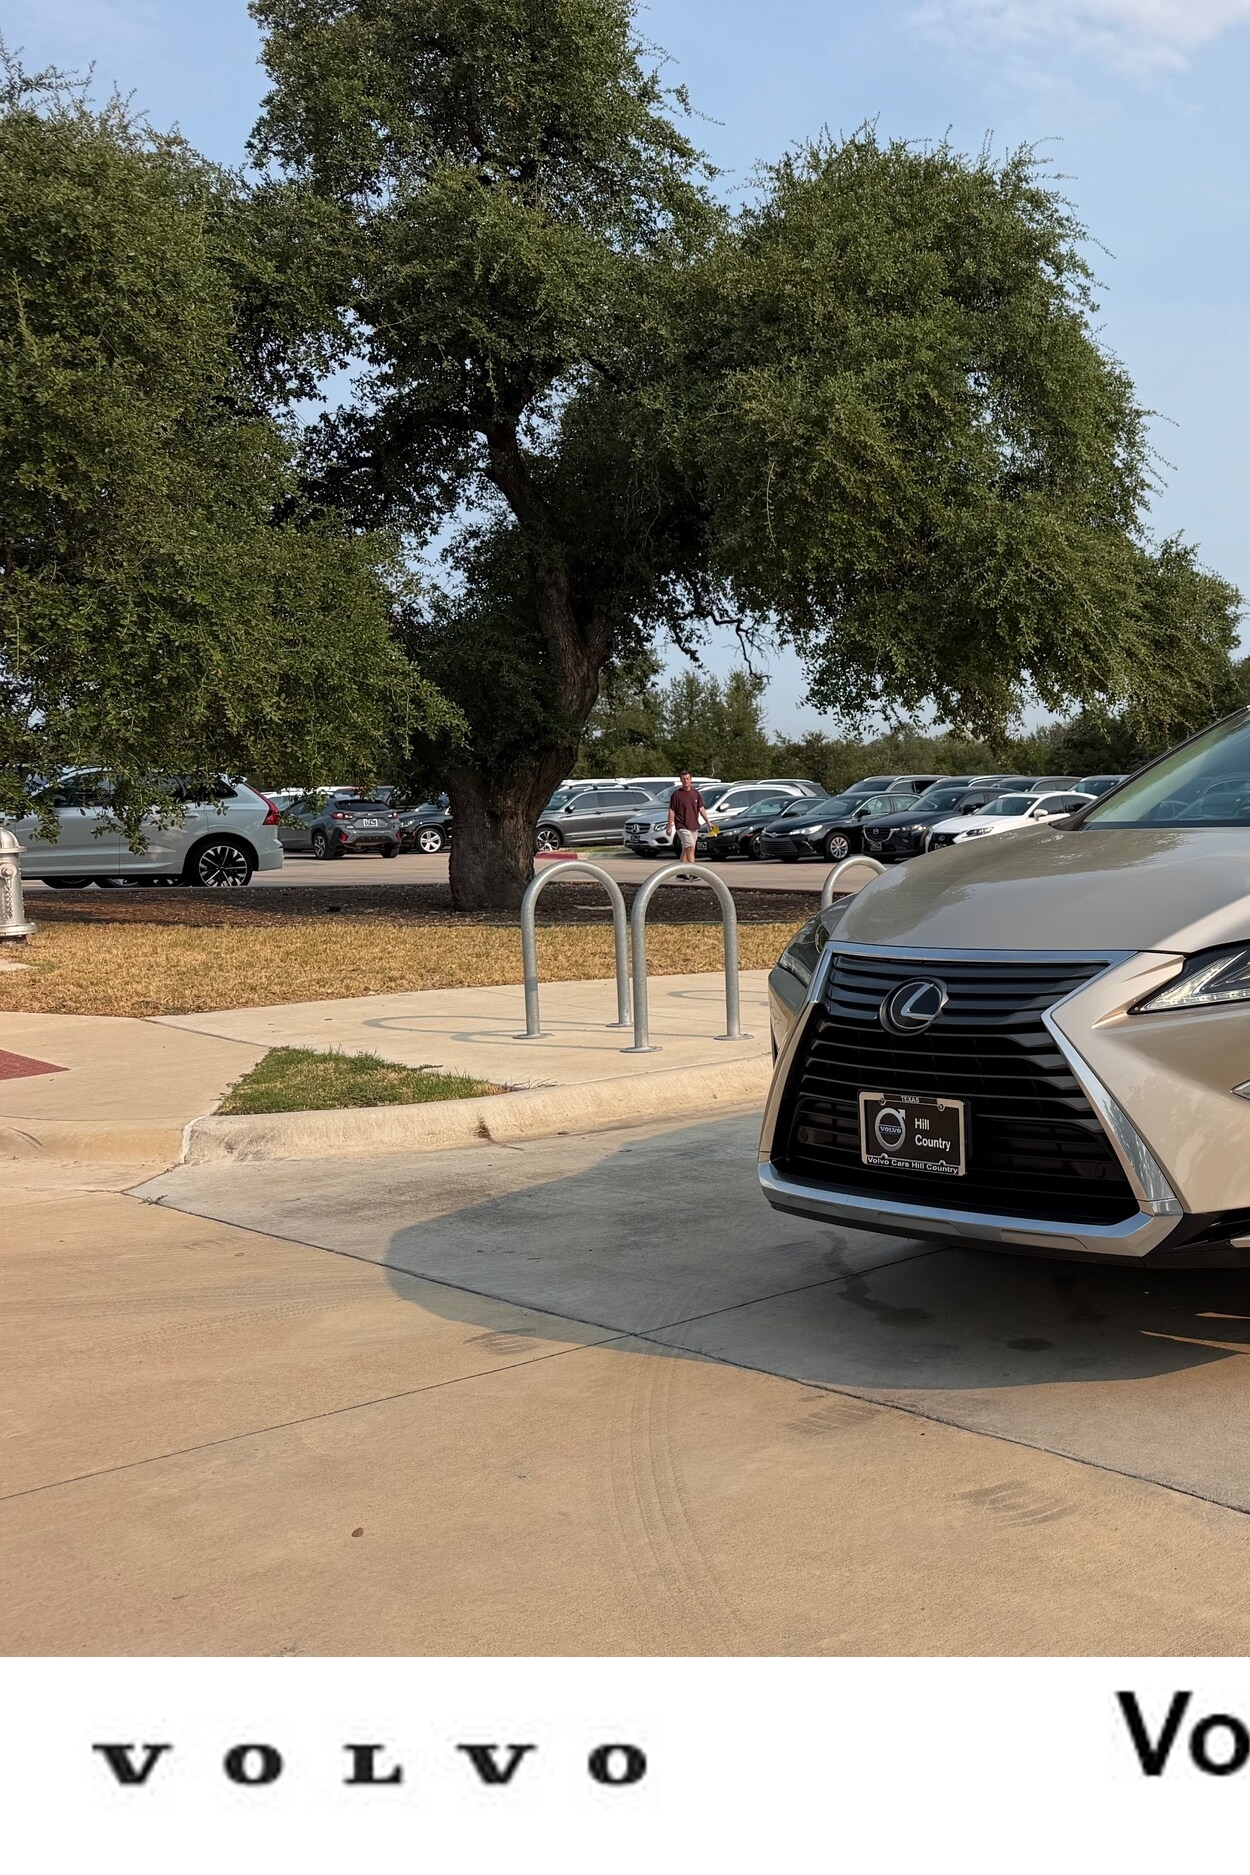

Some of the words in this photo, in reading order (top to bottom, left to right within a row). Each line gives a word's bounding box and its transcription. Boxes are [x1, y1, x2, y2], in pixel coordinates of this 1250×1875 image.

[902, 1095, 920, 1103] TEXAS
[880, 1126, 902, 1134] VOLVO
[914, 1117, 930, 1130] Hill
[914, 1134, 951, 1151] Country
[867, 1156, 890, 1165] Volvo
[891, 1158, 910, 1168] Cars
[911, 1161, 925, 1169] Hill
[926, 1163, 958, 1174] Country
